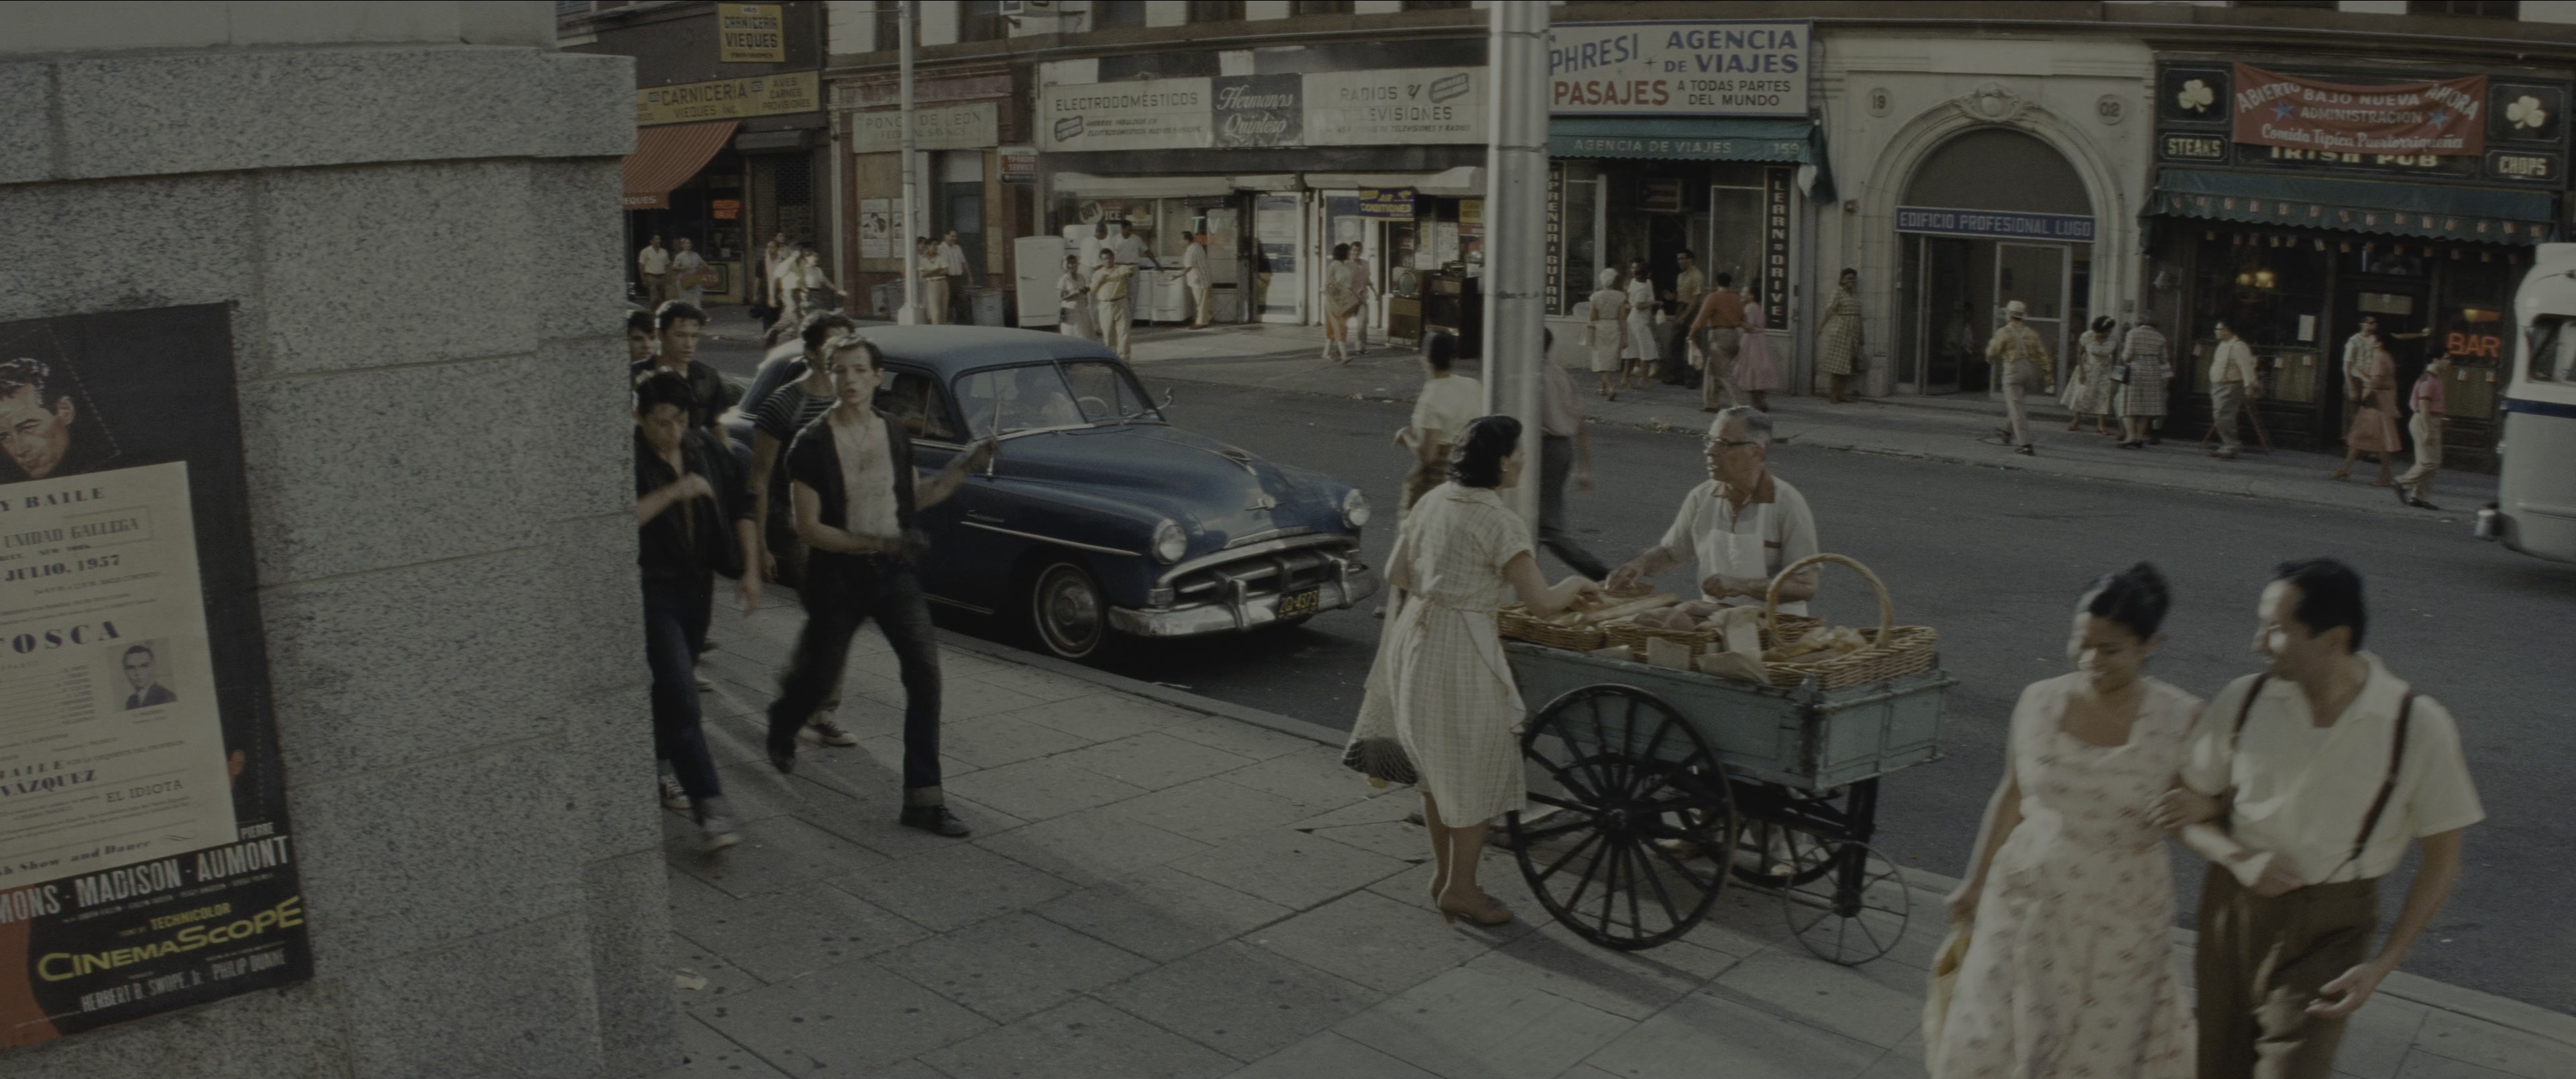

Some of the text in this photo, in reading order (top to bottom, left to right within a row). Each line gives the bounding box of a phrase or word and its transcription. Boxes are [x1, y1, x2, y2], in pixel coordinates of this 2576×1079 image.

[724, 32, 777, 50] VIEQUES
[1665, 30, 1798, 50] AGENCIA
[1550, 32, 1639, 76] PHRESI
[1664, 53, 1799, 74] DE VIAJES
[1216, 85, 1293, 109] Hermanos
[1341, 87, 1397, 101] RADIOS
[1554, 79, 1670, 106] PASAJES
[1676, 80, 1791, 93] A TODAS PARTES
[1056, 91, 1198, 111] ELECTRODOMÉSTICOS
[1688, 94, 1780, 106] DEL MUNDO
[1872, 95, 1886, 109] 19
[2236, 82, 2301, 113] ABIERTO
[2303, 89, 2353, 104] BAJO
[2359, 94, 2420, 106] NUEVA
[673, 105, 716, 118] VIEQUES
[865, 116, 902, 129] PONC
[920, 113, 938, 126] DE
[1224, 110, 1287, 139] Quintero
[2261, 123, 2311, 143] Comida
[1573, 139, 1800, 154] AGENCIA DE VIAJES 159
[2167, 138, 2222, 158] STEAKS
[2271, 146, 2438, 167] IRISH PUB
[2499, 156, 2548, 176] CHOPS
[1770, 180, 1786, 240] LEARN
[1899, 211, 2092, 238] EDIFICIO PROFESIONAL LUGO
[1770, 254, 1785, 317] DRIVE
[2446, 331, 2501, 358] BAR
[24, 486, 105, 509] BAILE
[3, 517, 140, 548] UNIDAD GALLEGA
[77, 554, 121, 572] 1957
[0, 621, 121, 654] OSCA
[1, 769, 98, 797] VÁZQUEZ
[107, 780, 183, 803] EL IDIOTA
[239, 821, 275, 839] PIERRE
[70, 848, 100, 862] and
[75, 858, 183, 907] MADISON
[197, 835, 288, 882] AUMONT
[150, 903, 232, 931] TECHNICOLOR
[211, 958, 248, 980] PHILIP
[80, 985, 133, 1013] HERBERT
